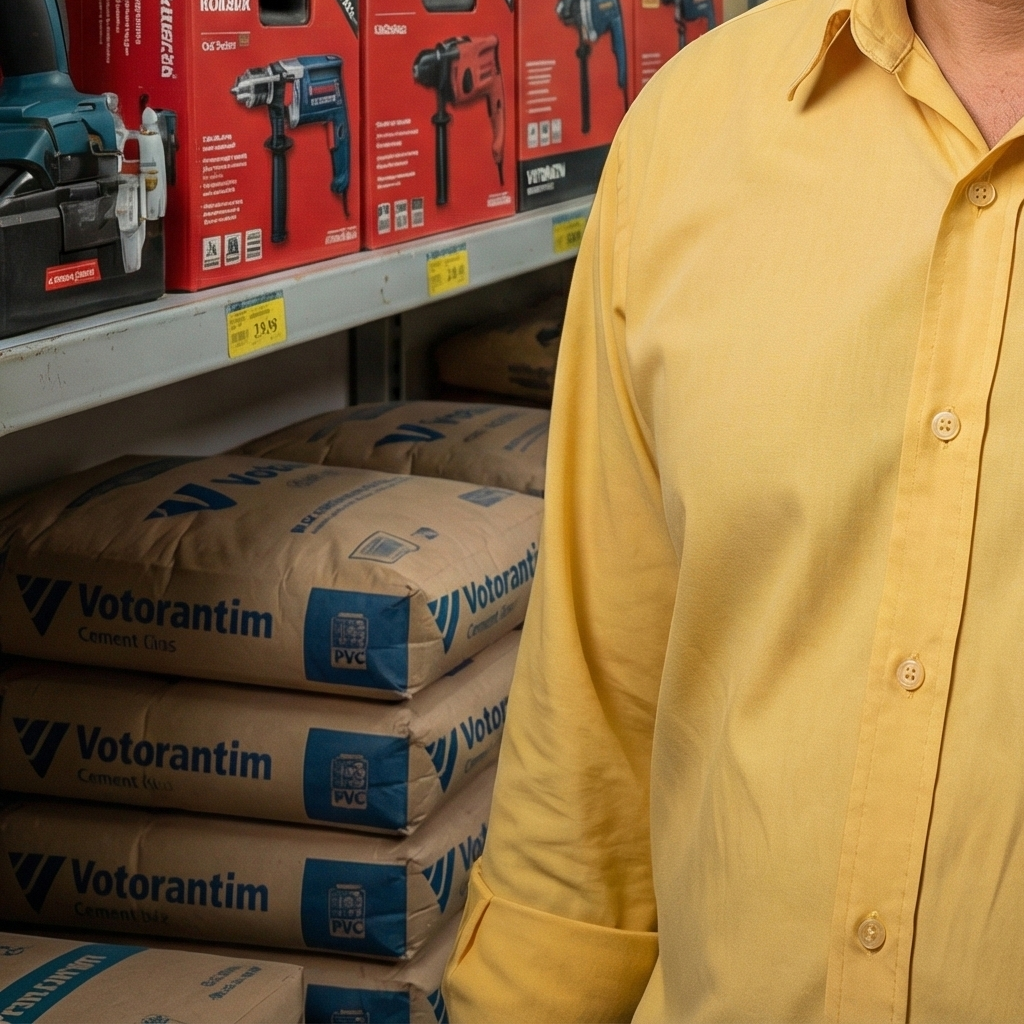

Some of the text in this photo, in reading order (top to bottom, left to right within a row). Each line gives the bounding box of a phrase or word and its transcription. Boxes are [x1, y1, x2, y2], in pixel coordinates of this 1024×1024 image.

[462, 541, 538, 615] Votoranti
[78, 582, 273, 639] Votorantim
[78, 626, 138, 650] Cement
[333, 648, 366, 666] PVC
[76, 724, 272, 781] Votorantim
[333, 789, 366, 807] PVC
[71, 858, 269, 913] Votorantim
[332, 919, 365, 938] PVC
